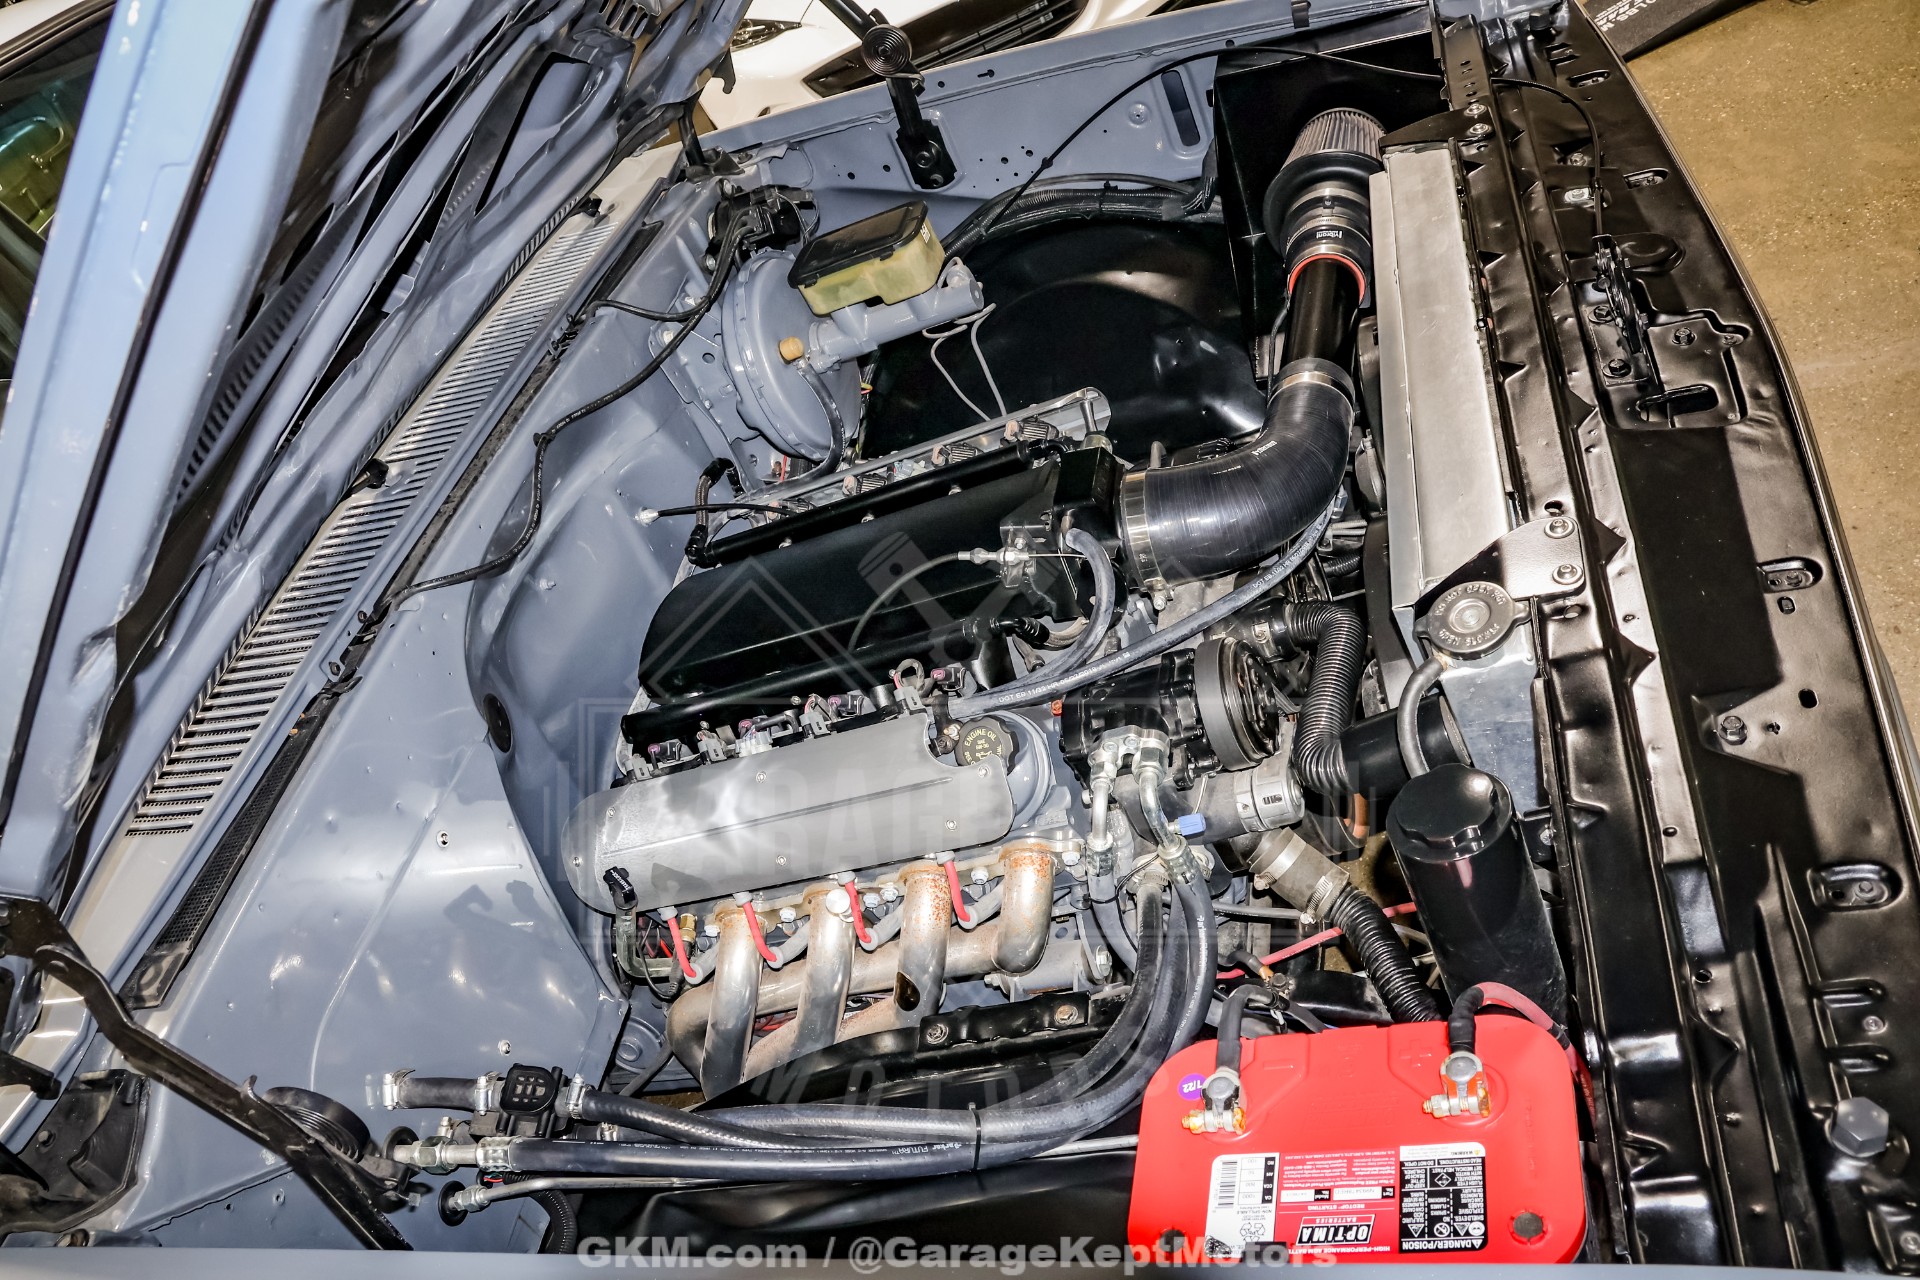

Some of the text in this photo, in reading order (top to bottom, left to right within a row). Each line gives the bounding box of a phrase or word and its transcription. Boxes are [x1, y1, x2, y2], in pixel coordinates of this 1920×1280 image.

[1445, 588, 1462, 604] NOT
[1466, 584, 1492, 594] OPEN
[965, 729, 996, 746] ENGINE OIL
[1301, 1225, 1369, 1242] OPTIMA
[1402, 1240, 1472, 1250] DANGER/POISON
